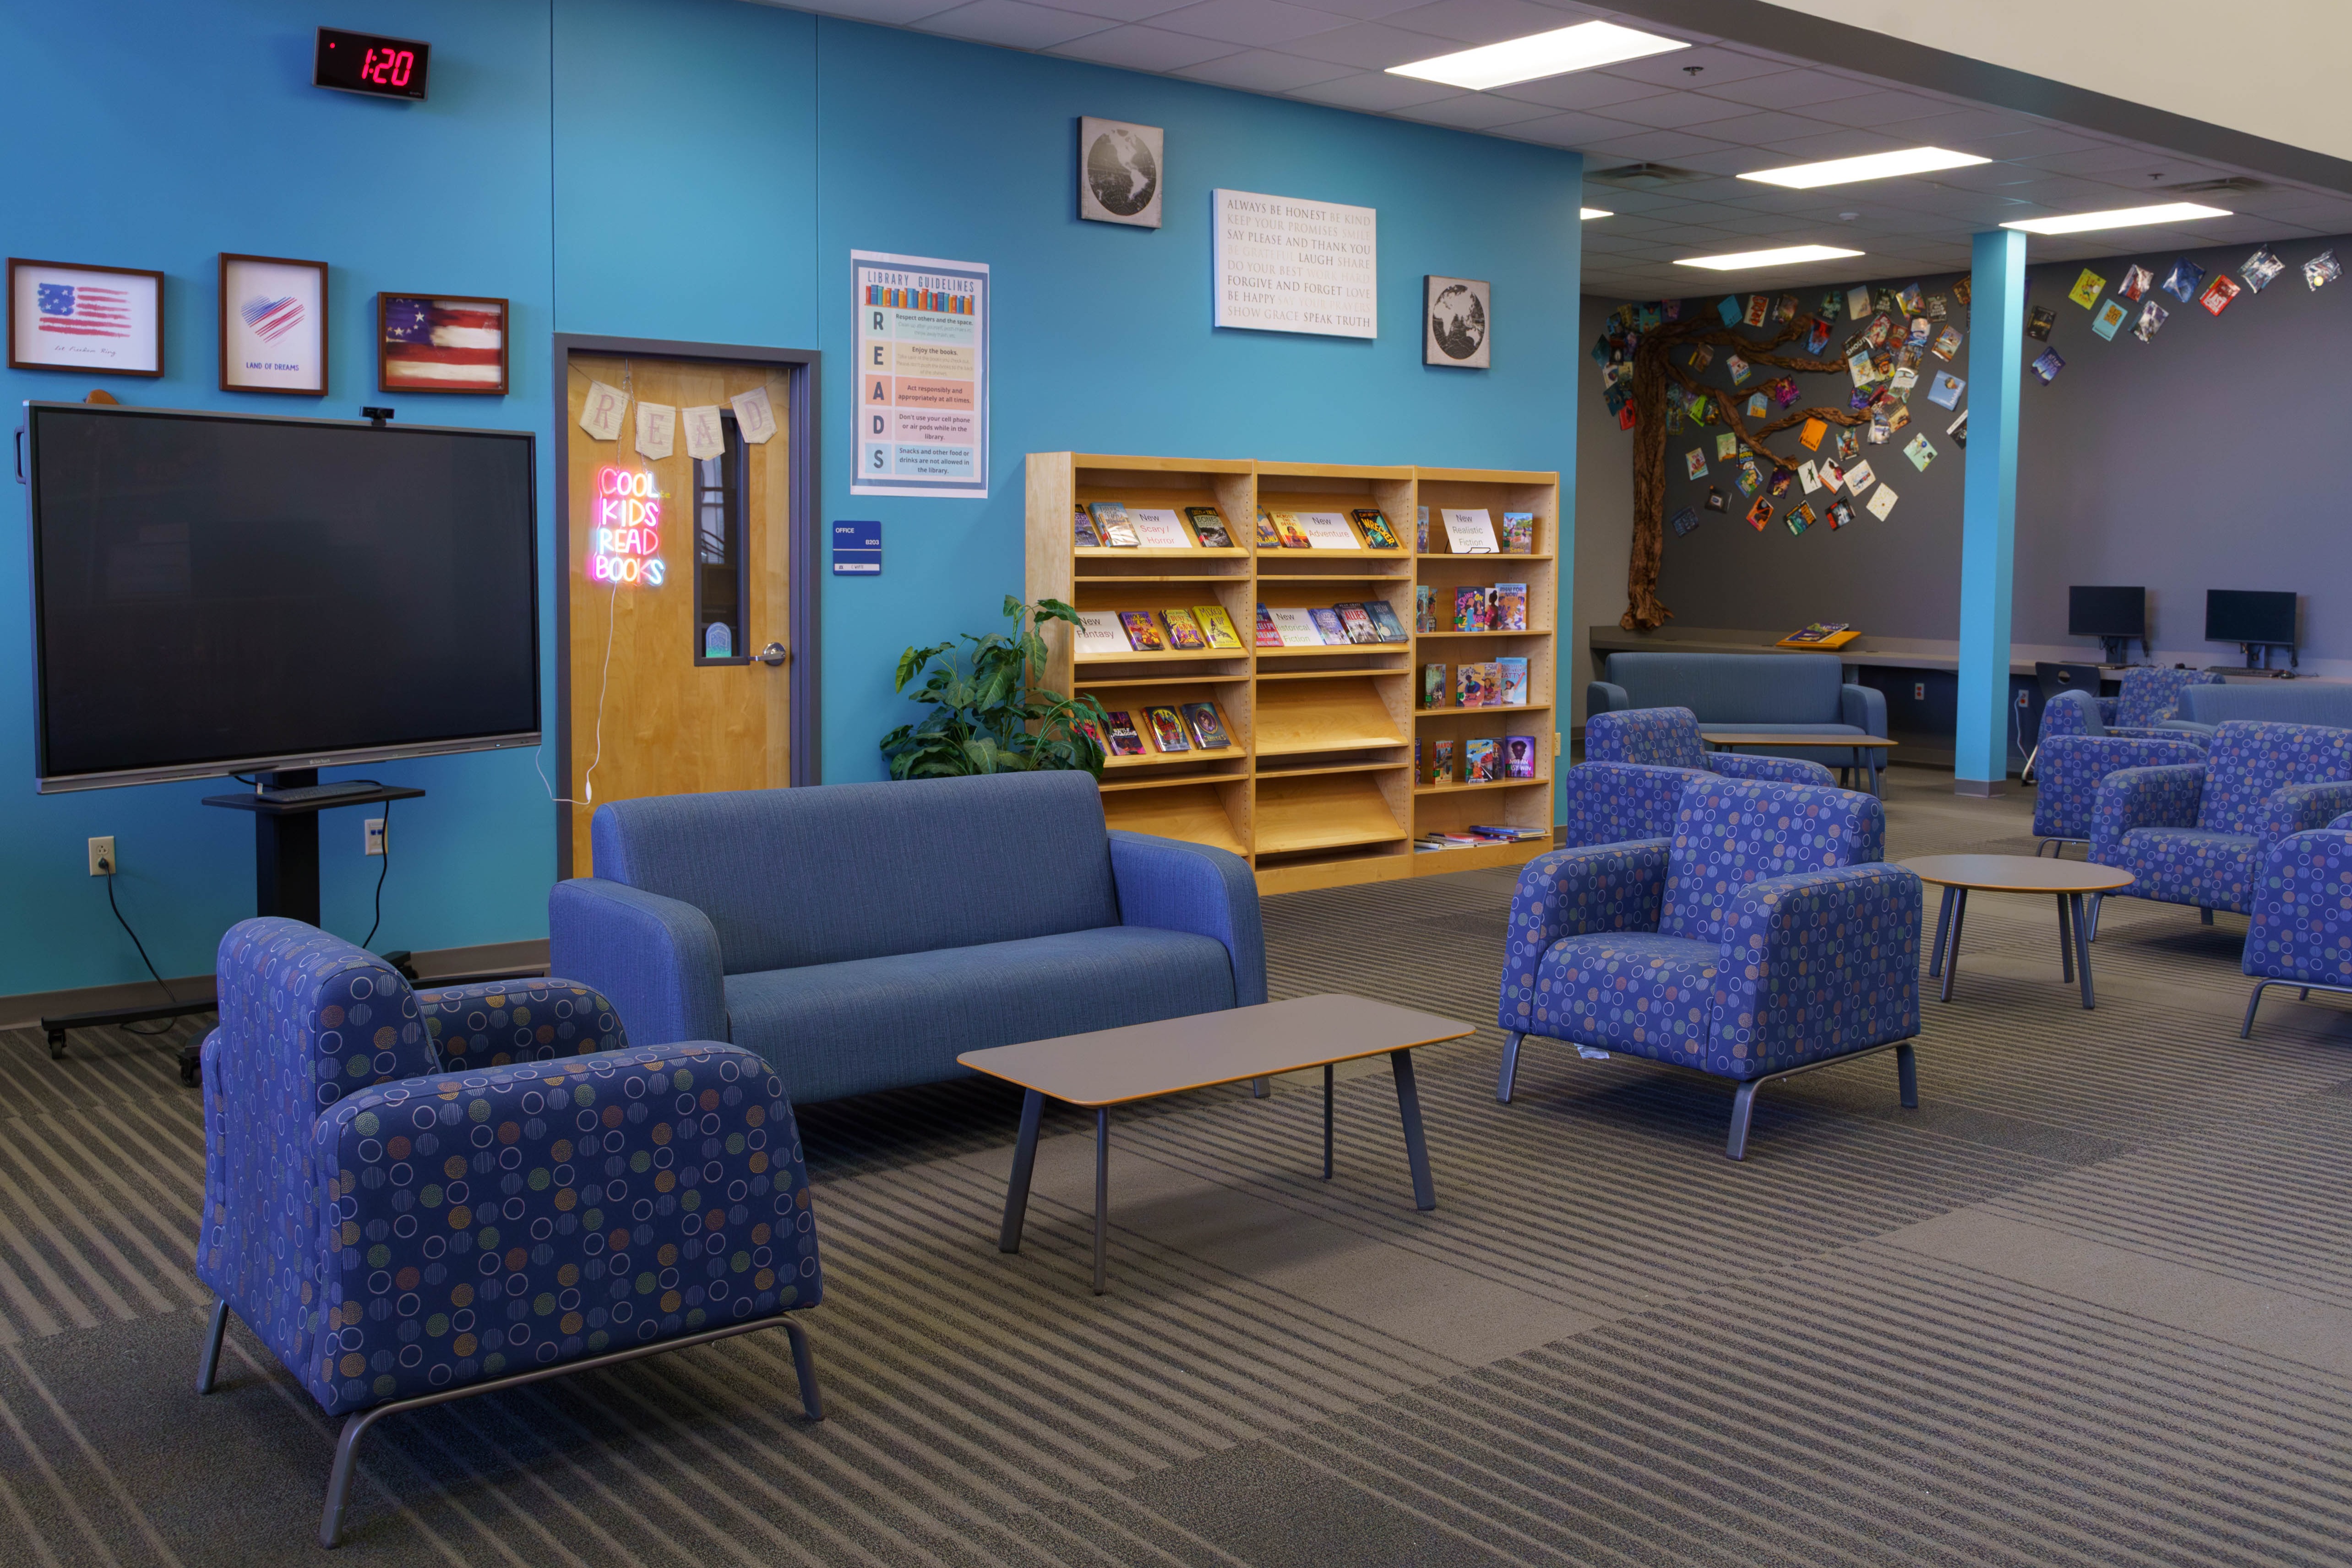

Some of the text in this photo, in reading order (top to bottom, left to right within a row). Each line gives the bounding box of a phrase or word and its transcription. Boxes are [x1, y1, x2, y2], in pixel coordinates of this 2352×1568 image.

[362, 48, 414, 86] 1:20
[1227, 199, 1371, 226] ALWAYS BE HONEST BE KIND
[1227, 214, 1371, 240] KEEP YOUR PROMISES SMILE
[1227, 229, 1371, 255] SAY PLEASE AND THANK YOU
[1228, 244, 1370, 269] BE GRATEFUL LAUGH SHARE
[868, 271, 974, 292] LIBRARY GUIDELINES
[1228, 260, 1370, 283] DO YOUR BEST WORK HARD
[1227, 275, 1371, 299] FORGIVE AND FORGET LOVE
[1228, 290, 1371, 313] BE HAPPY SAY YOUR PRAYERS
[873, 311, 883, 330] R
[1228, 305, 1371, 327] SHOW GRACE SPEAK TRUTH
[100, 348, 116, 357] Ring
[874, 346, 883, 365] E
[873, 381, 884, 400] A
[873, 415, 884, 434] D
[873, 449, 883, 468] S
[600, 468, 659, 498] COOL
[602, 498, 659, 528] KIDS
[1139, 514, 1160, 522] New
[1140, 525, 1165, 534] Scary
[1361, 518, 1395, 544] WRECKER
[599, 528, 659, 555] READ
[596, 555, 664, 585] BOOKS
[1080, 617, 1100, 626] New
[1199, 608, 1222, 618] MIXED
[1216, 617, 1224, 625] UP
[1344, 610, 1367, 620] ALLIES
[1076, 630, 1114, 639] Fantasy
